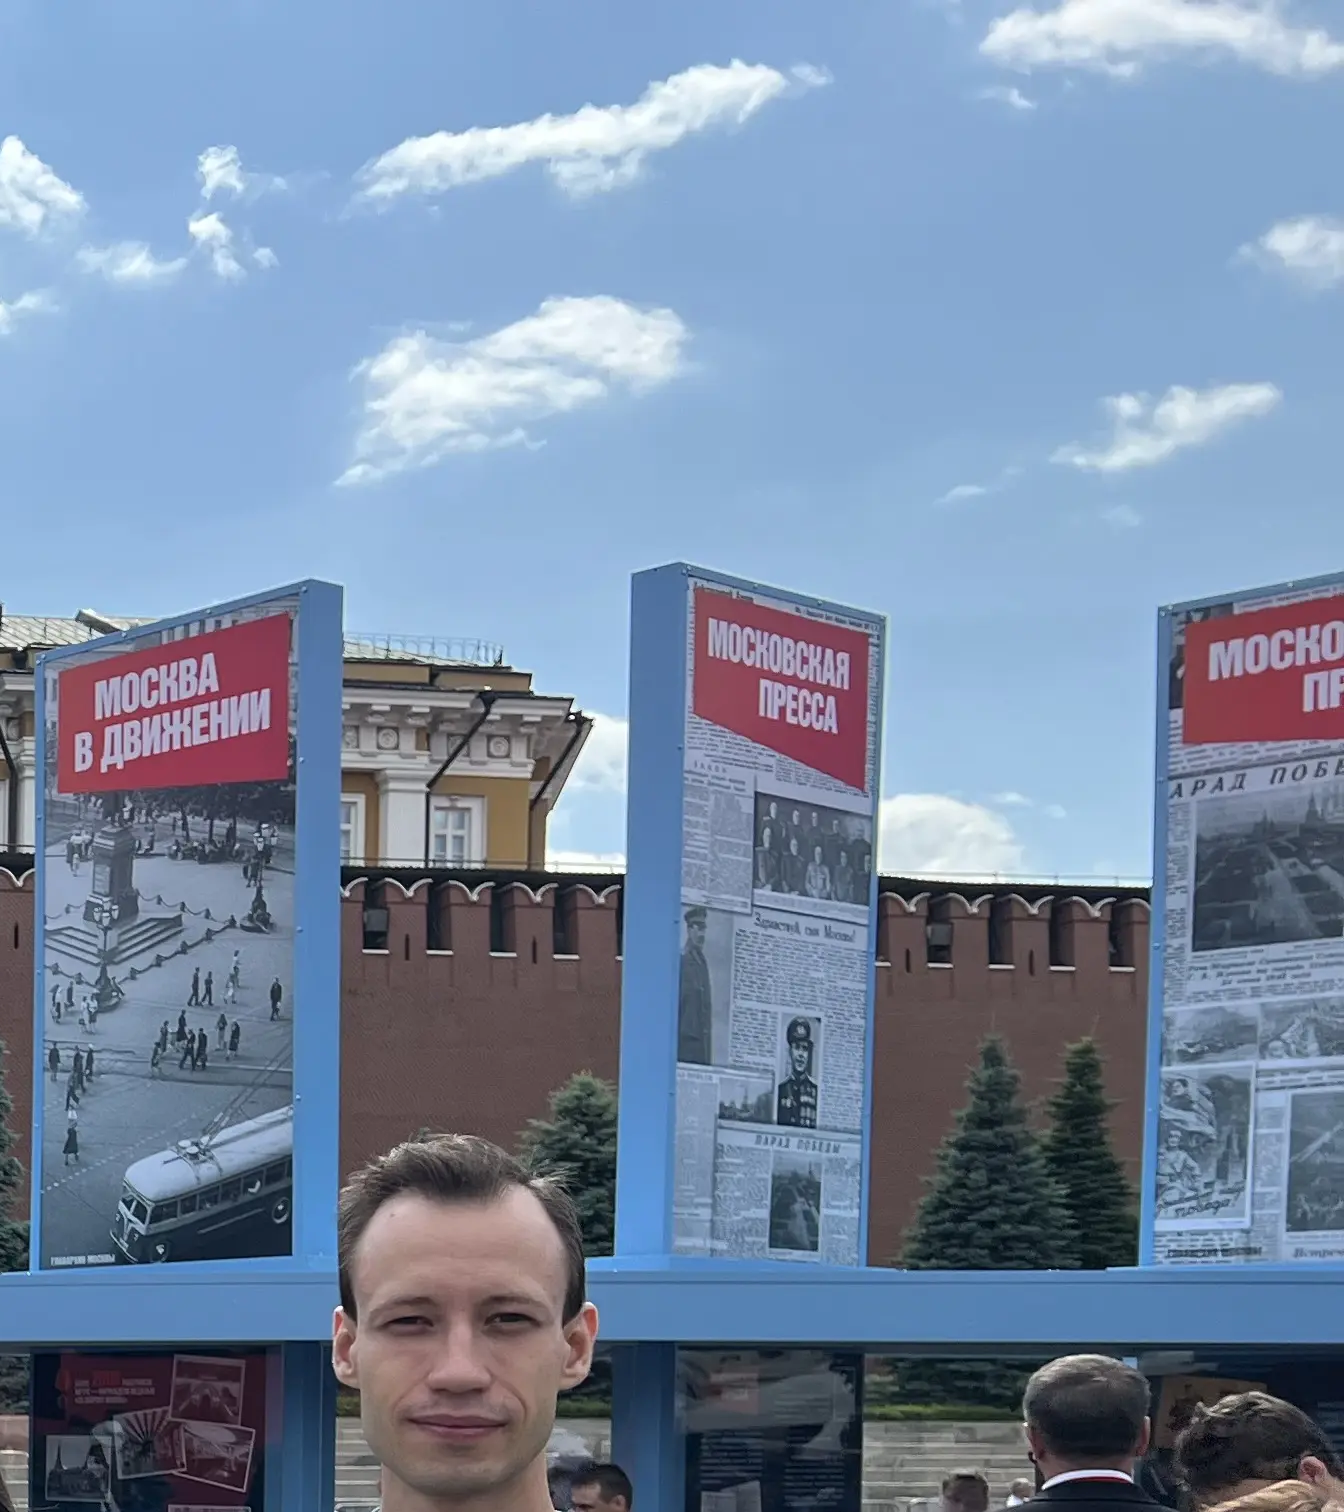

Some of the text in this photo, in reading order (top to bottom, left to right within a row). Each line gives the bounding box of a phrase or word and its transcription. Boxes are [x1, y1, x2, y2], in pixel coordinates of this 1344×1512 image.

[708, 617, 850, 690] МОСКОВСКАЯ
[1208, 620, 1344, 682] МОСКО
[94, 652, 219, 721] МОСКВА
[758, 678, 839, 734] ПРЕССА
[74, 688, 270, 774] В ДВИЖЕНИИ
